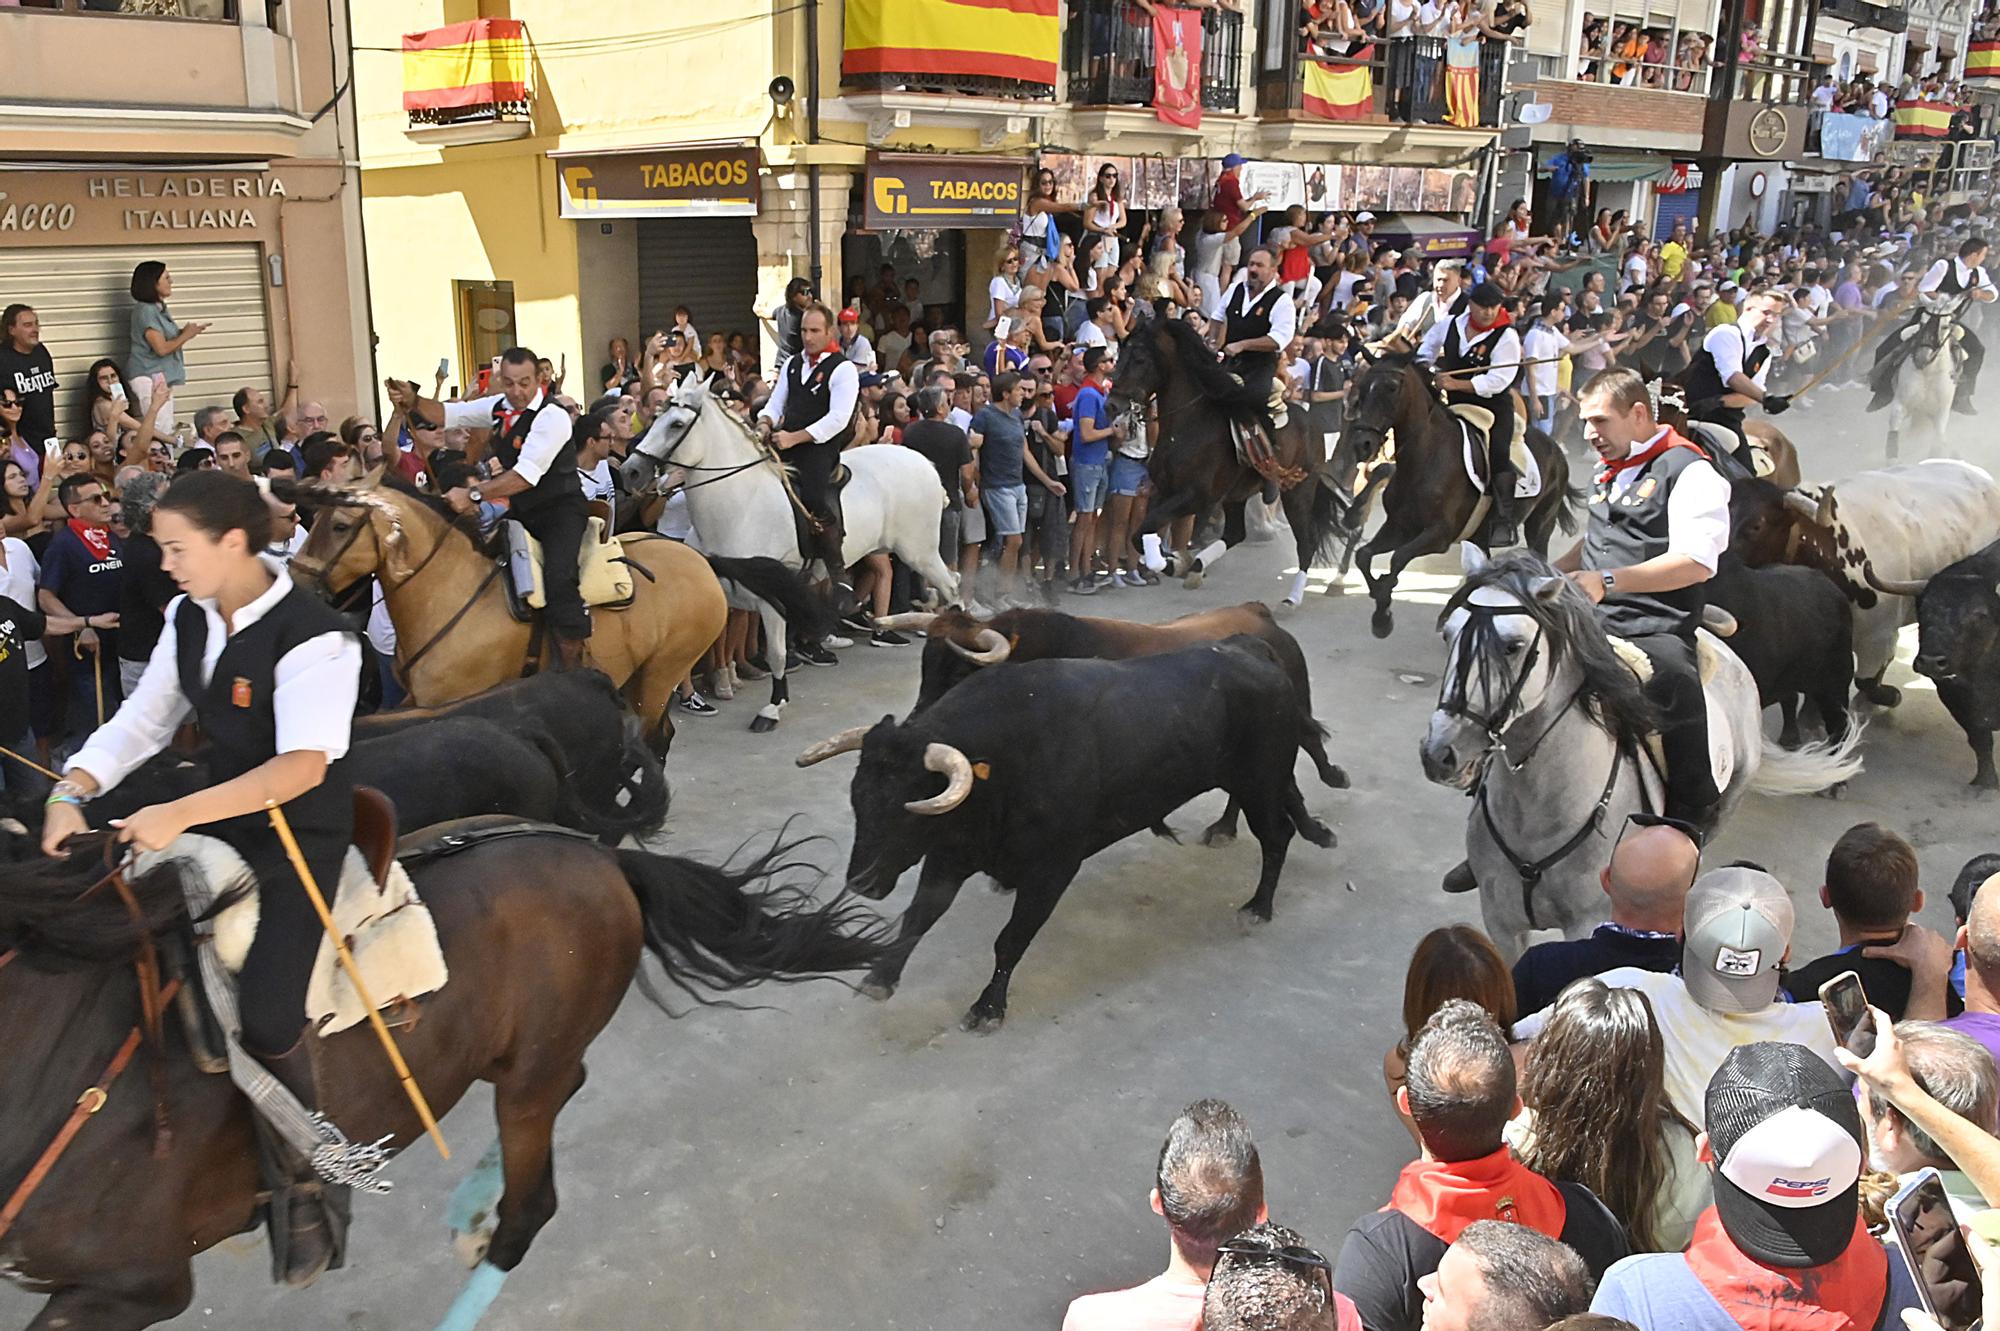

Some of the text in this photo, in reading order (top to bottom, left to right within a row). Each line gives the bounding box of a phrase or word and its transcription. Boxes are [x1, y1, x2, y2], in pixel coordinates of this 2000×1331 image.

[640, 159, 748, 188] TABACOS
[89, 177, 287, 199] HELADERIA
[930, 181, 1018, 200] TABACOS
[124, 208, 257, 231] ITALIANA
[14, 371, 55, 393] BEATLES
[1773, 1177, 1831, 1188] PEPSI
